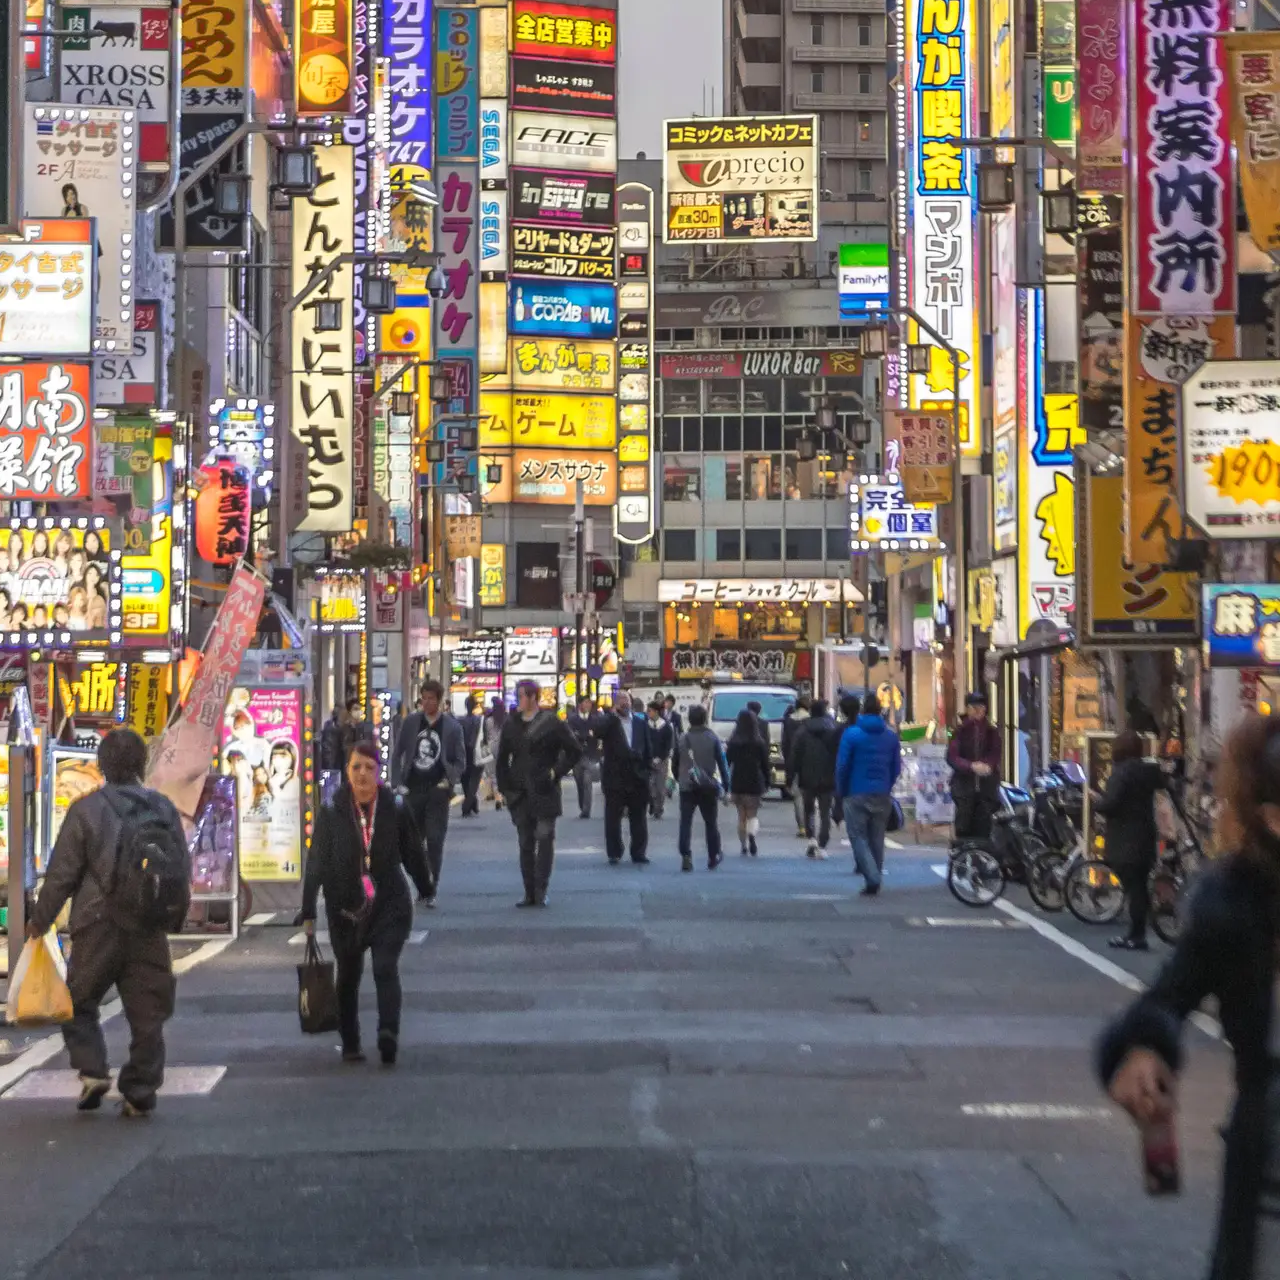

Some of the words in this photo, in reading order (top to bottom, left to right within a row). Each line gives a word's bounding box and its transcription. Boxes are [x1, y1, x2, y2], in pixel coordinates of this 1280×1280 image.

[142, 19, 169, 30] イタリ
[516, 13, 613, 49] 全店営業中
[63, 64, 166, 86] XROSS
[75, 88, 156, 110] CASA
[56, 121, 118, 138] タイ古式
[447, 94, 473, 154] クラブ
[669, 123, 812, 144] コミック&ネットカフェ
[481, 109, 500, 169] SEGA
[516, 126, 614, 148] FACE
[36, 140, 118, 157] マッサージ
[36, 163, 59, 176] 2F
[670, 192, 720, 207] 新宿最大
[481, 201, 500, 260] SEGA
[513, 228, 614, 256] ビリヤード&ダーツ
[442, 171, 474, 345] カラオケ
[544, 257, 578, 275] ゴルフ
[925, 199, 963, 341] マンボー
[516, 341, 610, 375] まんが喫茶
[743, 351, 792, 377] LUXOR
[795, 352, 821, 376] Bar
[516, 410, 577, 437] ゲーム
[519, 458, 608, 482] メンズサウナ
[886, 512, 934, 534] 個室
[681, 581, 742, 600] コーヒー
[787, 581, 819, 600] クール
[508, 649, 555, 667] ゲーム
[673, 650, 785, 671] 無料案内所
